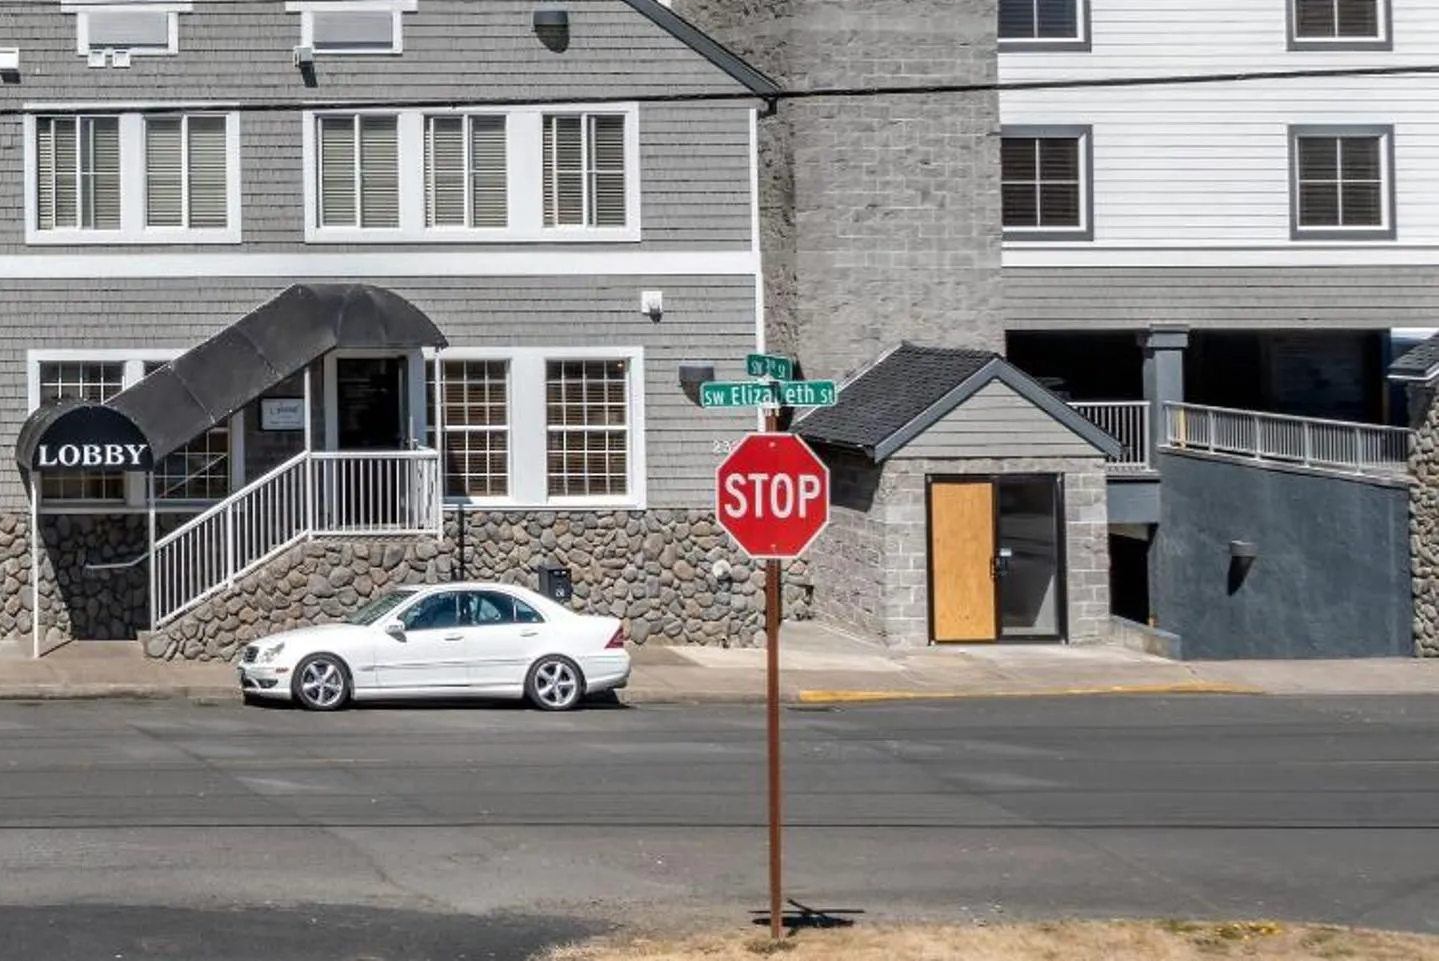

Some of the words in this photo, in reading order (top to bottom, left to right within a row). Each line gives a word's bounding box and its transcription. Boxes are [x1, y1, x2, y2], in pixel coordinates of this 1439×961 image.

[731, 384, 815, 406] Elizaeth
[38, 444, 148, 467] LOBBY
[724, 472, 821, 520] STOP
